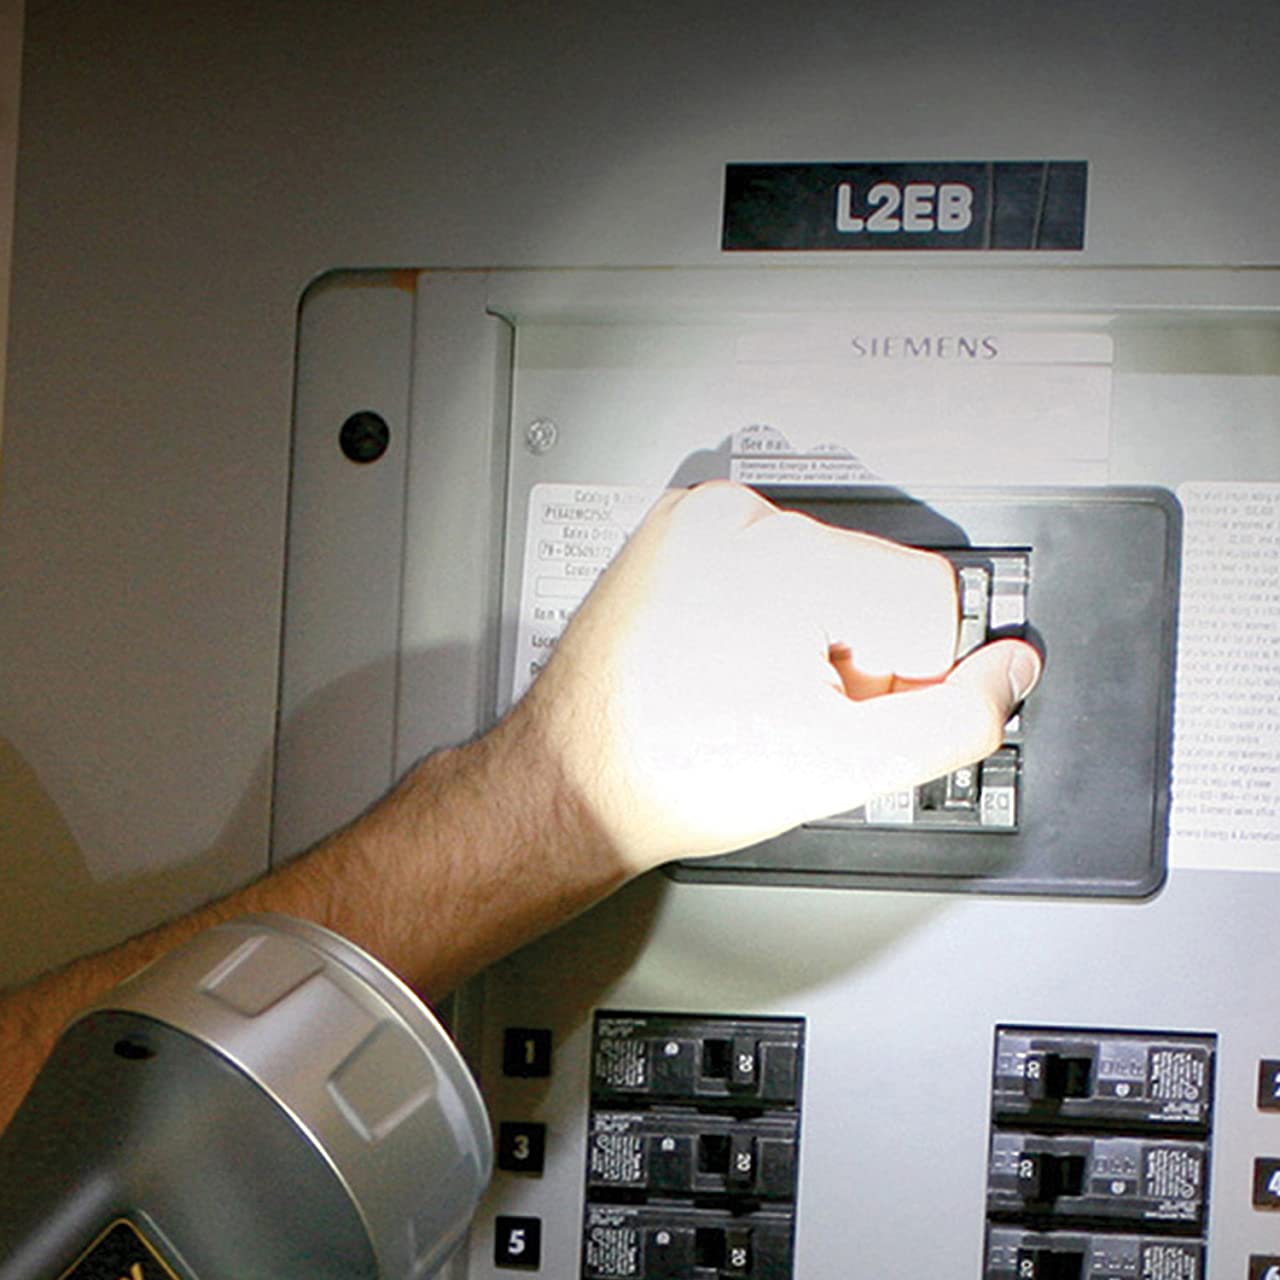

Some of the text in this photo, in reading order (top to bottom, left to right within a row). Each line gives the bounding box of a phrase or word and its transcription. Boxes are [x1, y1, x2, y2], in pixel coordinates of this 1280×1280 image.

[836, 183, 973, 233] L2EB
[851, 336, 999, 360] SIEMENS
[983, 793, 1010, 810] 20
[523, 1039, 536, 1065] 1
[514, 1135, 529, 1159] 3
[1268, 1170, 1280, 1196] 4
[508, 1230, 525, 1254] 5
